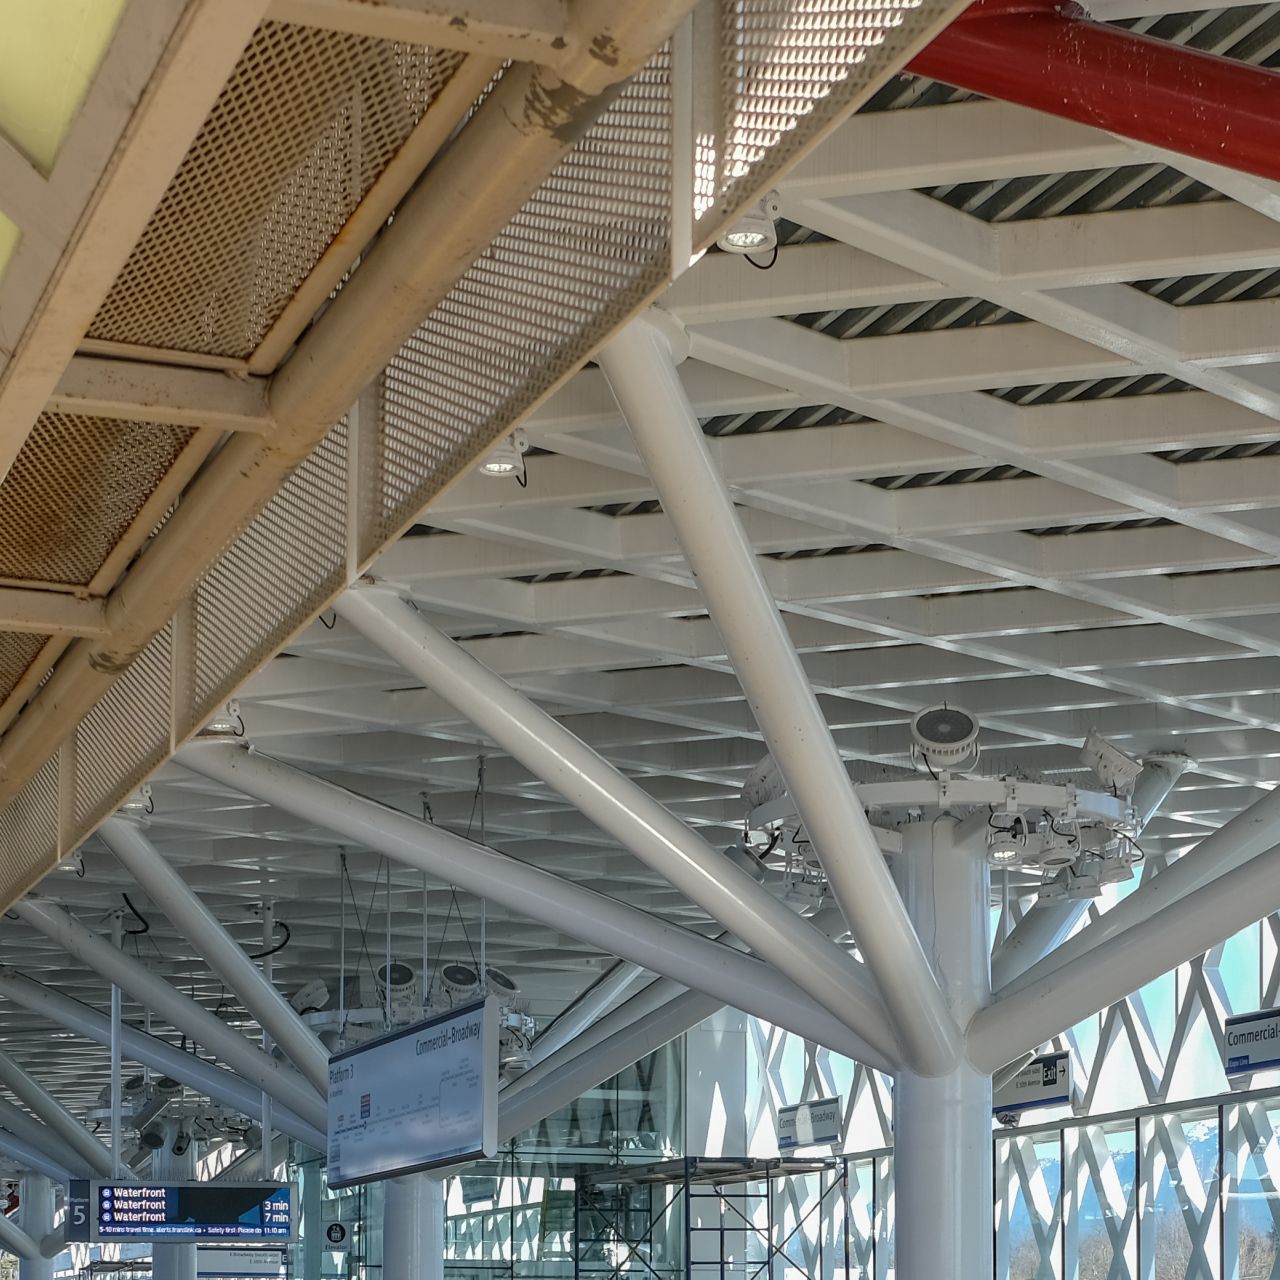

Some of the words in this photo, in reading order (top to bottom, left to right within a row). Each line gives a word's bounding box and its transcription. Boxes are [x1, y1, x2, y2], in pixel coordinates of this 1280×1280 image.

[330, 1064, 350, 1085] Platform
[349, 1063, 354, 1080] 3
[1044, 1065, 1057, 1082] Exit
[113, 1188, 166, 1198] Waterfront
[113, 1200, 166, 1210] Waterfront
[265, 1202, 271, 1210] 3
[272, 1201, 289, 1210] min
[73, 1205, 86, 1226] 5
[113, 1212, 166, 1222] Waterfront
[265, 1213, 271, 1222] 7
[272, 1212, 289, 1222] min
